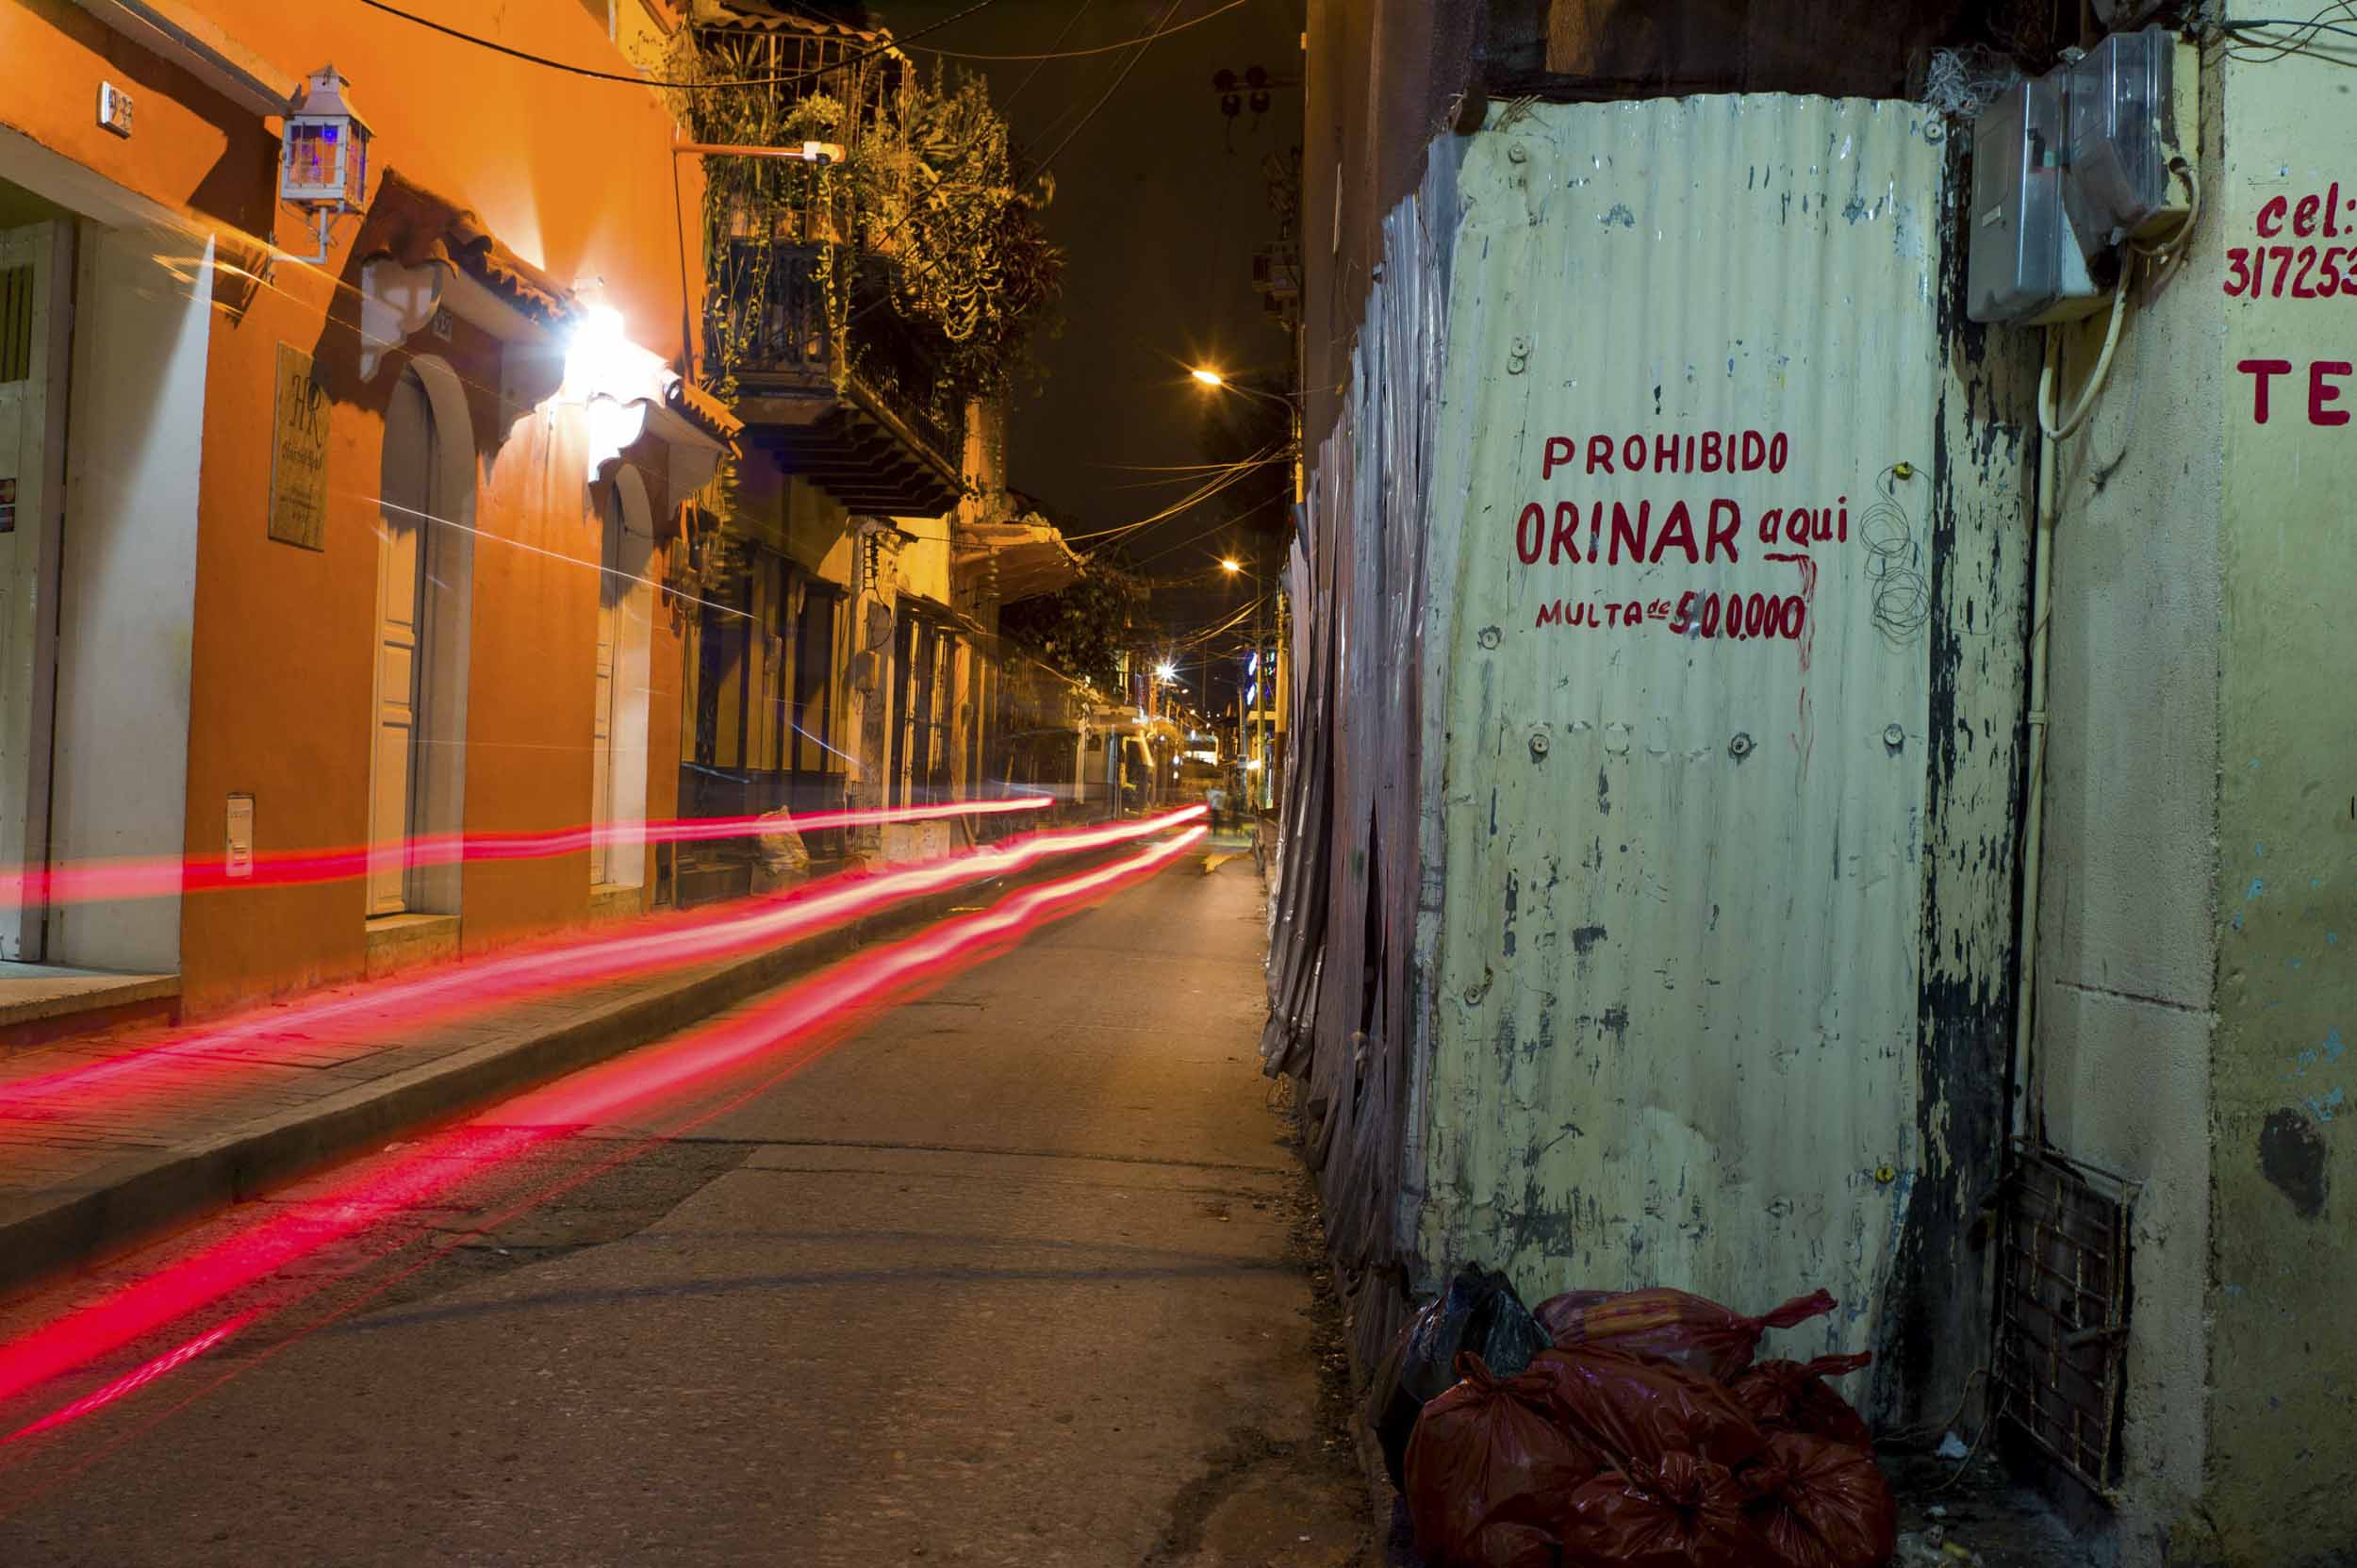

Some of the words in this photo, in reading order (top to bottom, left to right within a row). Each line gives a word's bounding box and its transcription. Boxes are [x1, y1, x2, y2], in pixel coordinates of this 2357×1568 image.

[2255, 181, 2357, 239] cel:
[2235, 358, 2353, 426] TE
[1542, 430, 1788, 480] PROHIBIDO
[1516, 498, 1742, 566] ORINAR
[1536, 599, 1643, 629] MULTA
